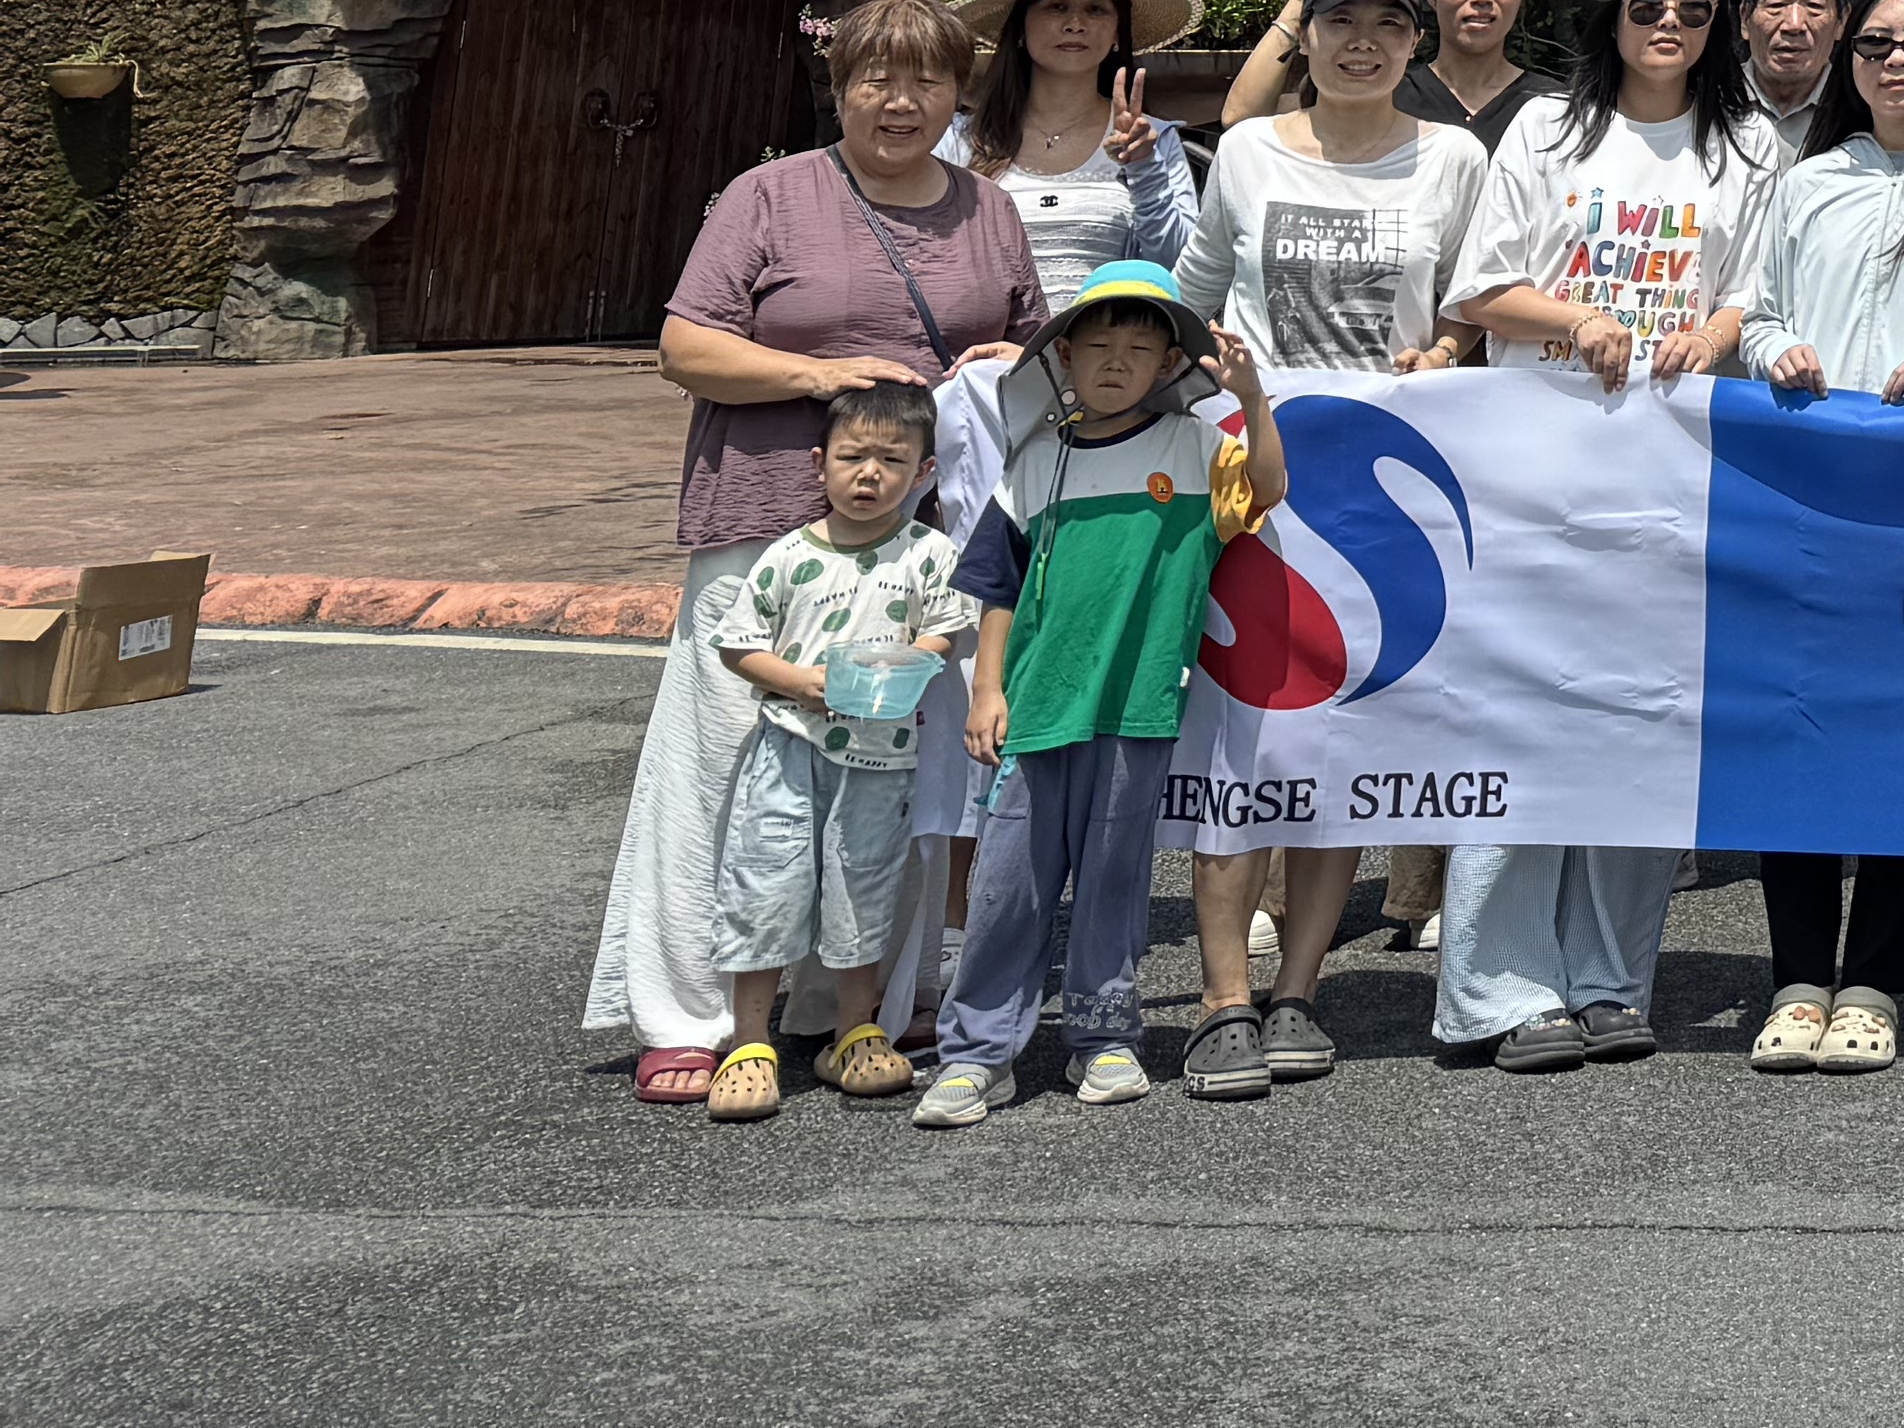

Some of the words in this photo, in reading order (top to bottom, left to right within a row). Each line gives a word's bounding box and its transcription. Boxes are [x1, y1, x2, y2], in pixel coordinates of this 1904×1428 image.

[1281, 214, 1294, 224] IT
[1300, 215, 1325, 226] ALL
[1617, 199, 1700, 239] WILL
[1305, 227, 1345, 238] WITH
[1351, 231, 1362, 239] A
[1276, 239, 1386, 263] DREAM
[1554, 280, 1624, 305] GREAT
[1349, 771, 1508, 820] STAGE
